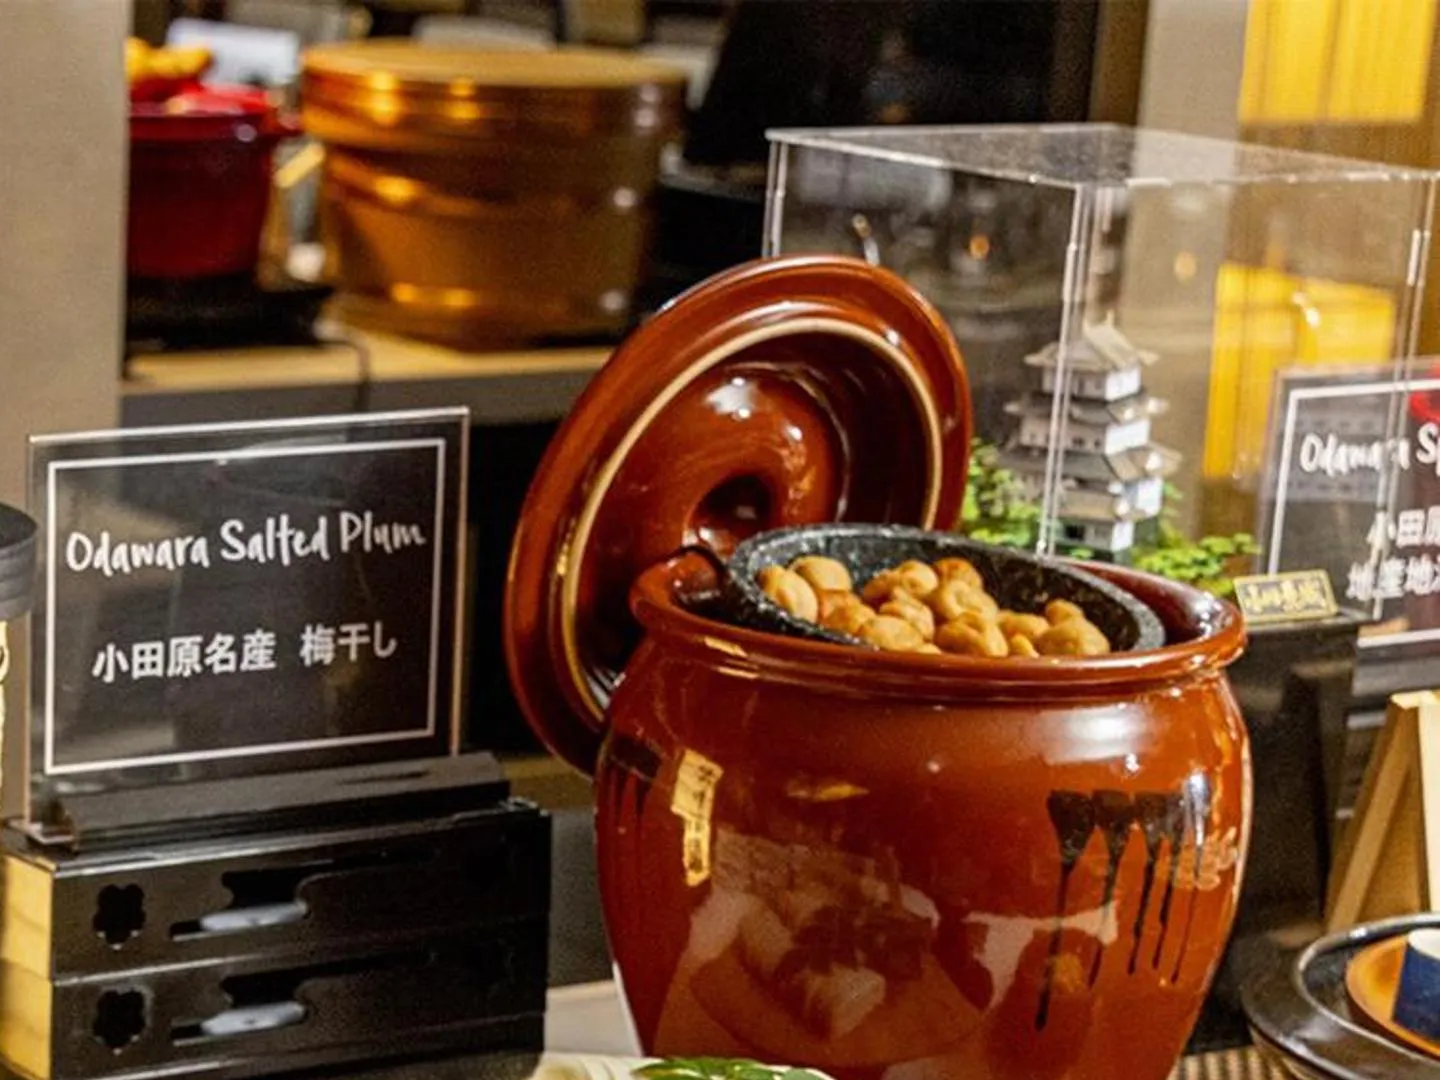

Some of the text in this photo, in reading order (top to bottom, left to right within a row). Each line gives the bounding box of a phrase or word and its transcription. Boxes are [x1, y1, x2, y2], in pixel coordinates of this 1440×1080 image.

[65, 510, 427, 576] Odawara Salted Plum
[91, 620, 398, 683] 小田原名産 梅干し
